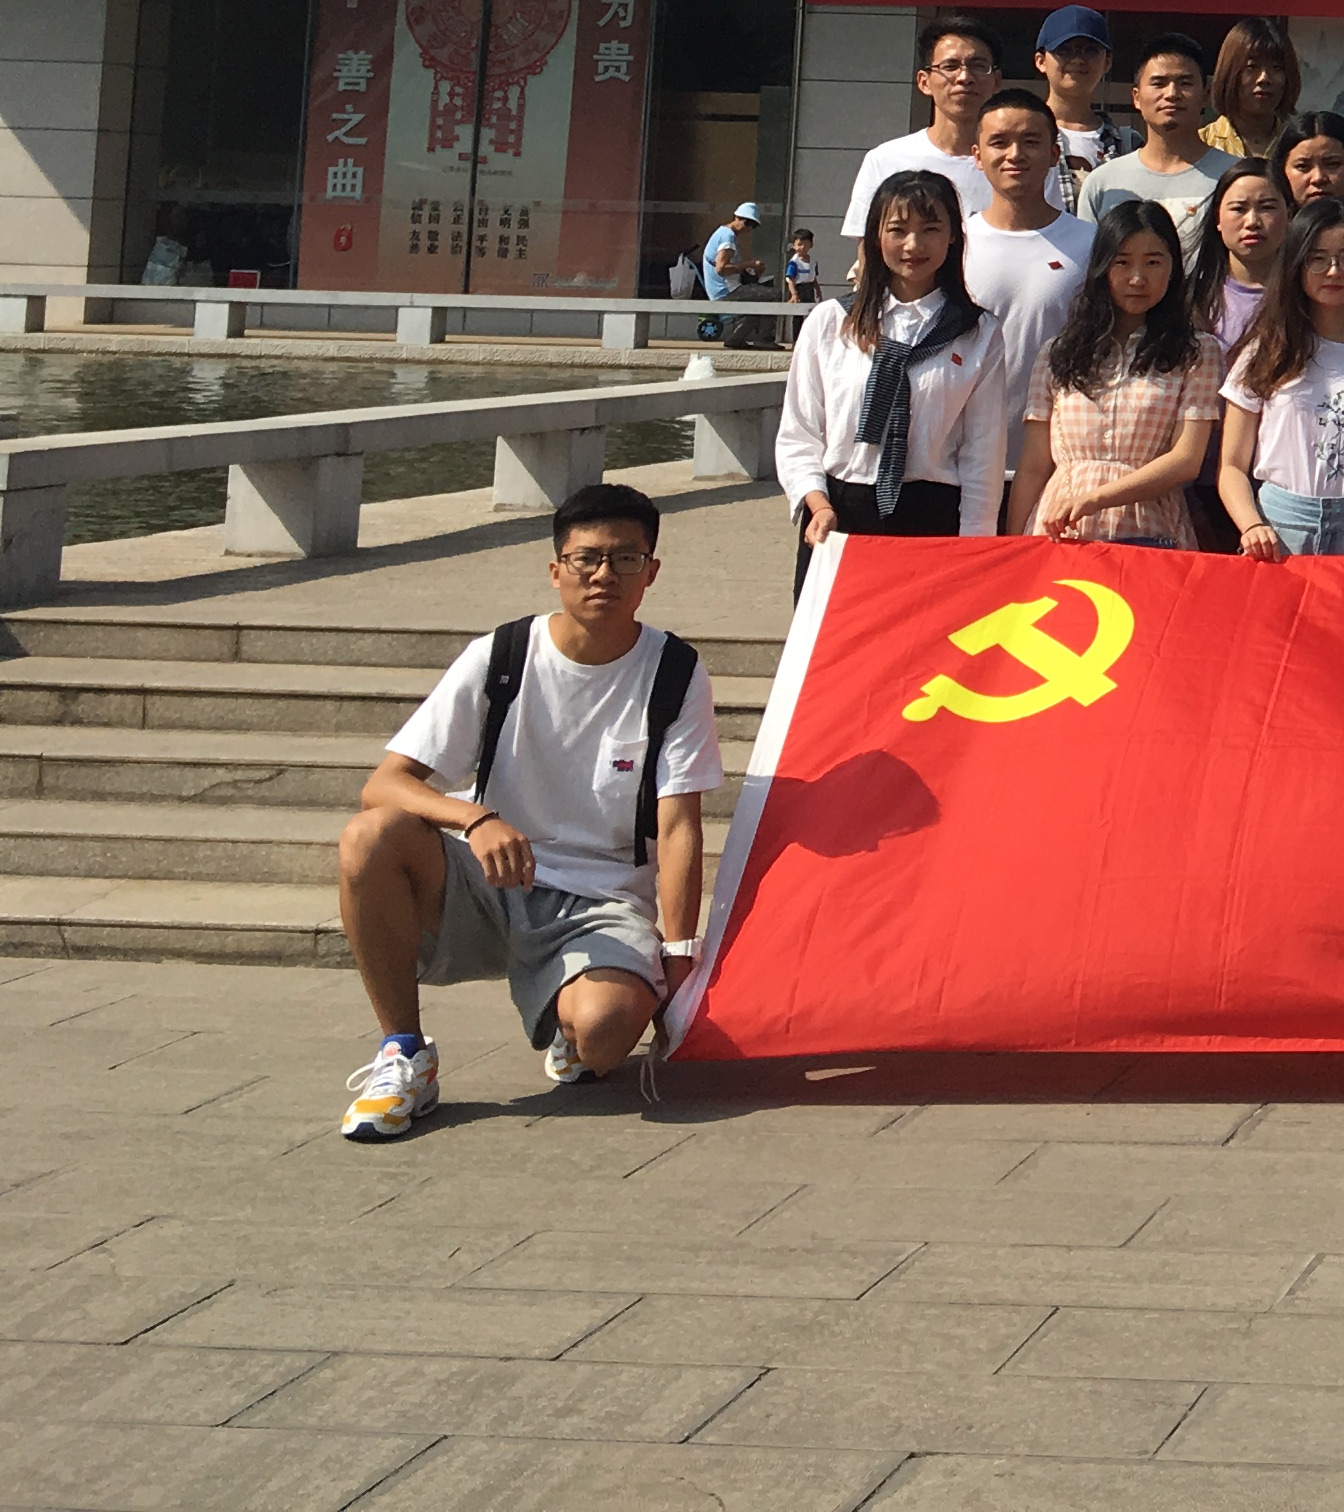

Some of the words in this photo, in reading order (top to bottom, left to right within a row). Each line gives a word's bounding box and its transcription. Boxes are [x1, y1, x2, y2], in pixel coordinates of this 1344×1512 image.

[326, 50, 375, 201] 善之曲
[514, 234, 529, 260] 民主
